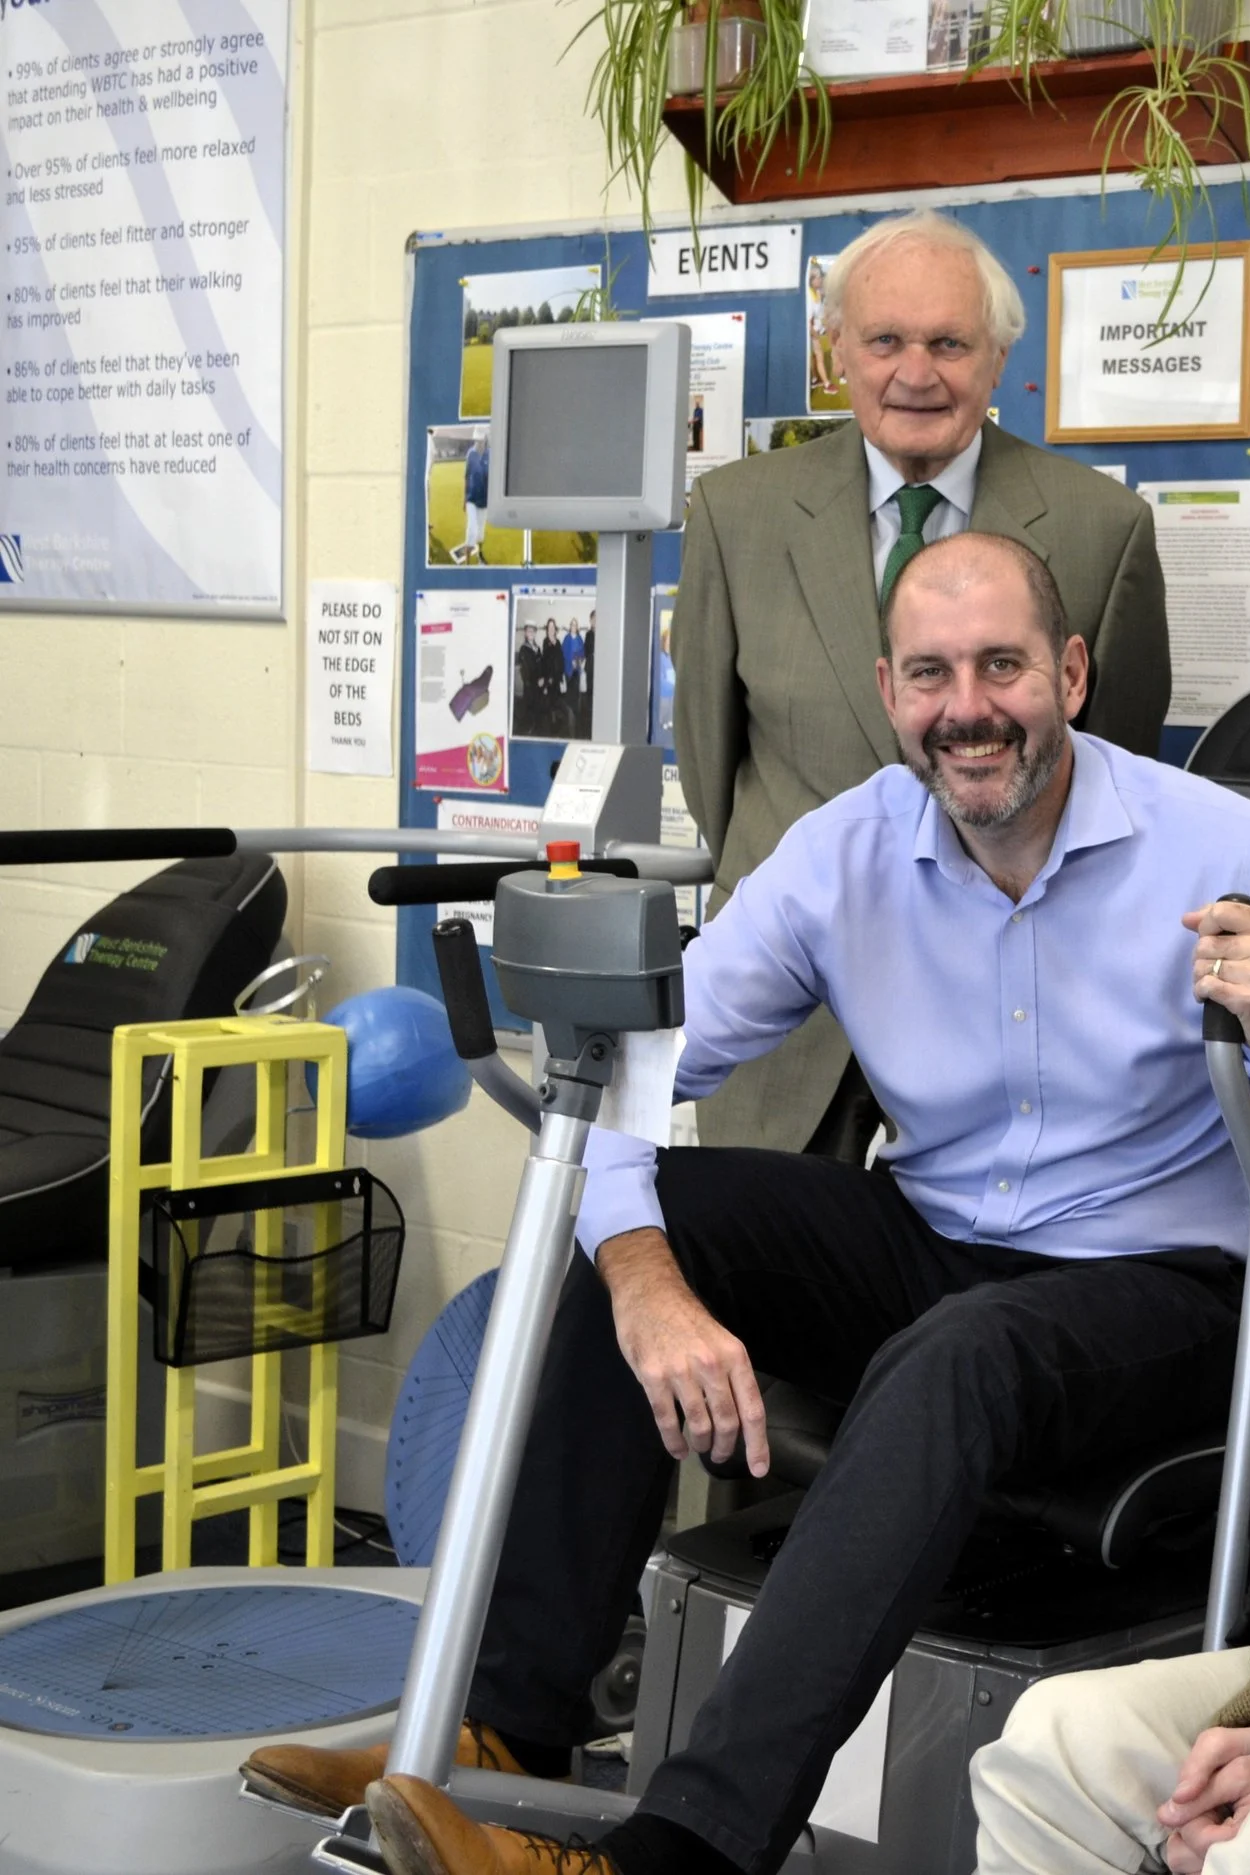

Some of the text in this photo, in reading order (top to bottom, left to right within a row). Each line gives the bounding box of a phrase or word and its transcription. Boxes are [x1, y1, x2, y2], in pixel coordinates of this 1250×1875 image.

[16, 32, 264, 80] 99% of clients agree or strongly agree
[8, 57, 258, 107] that attending WBTC has had a positive
[8, 88, 217, 134] impact on their health & wellbeing
[15, 136, 256, 180] Over 95% of clients feel more relaxed
[7, 179, 104, 206] and less stressed
[14, 217, 250, 255] 95% of clients feel fitter and stronger
[678, 242, 769, 275] EVENTS
[14, 271, 243, 304] 80% of clients feel that their walking
[7, 309, 82, 331] has improved
[1100, 321, 1207, 342] IMPORTANT
[14, 350, 240, 378] 86% of clients feel that they've been
[1102, 356, 1203, 376] MESSAGES
[7, 377, 216, 405] able to cope better with daily tasks
[14, 427, 252, 452] 80% of clients feel that at least one of
[7, 454, 217, 477] their health concerns have reduced
[322, 602, 382, 619] PLEASE DO
[318, 629, 383, 646] NOT SIT ON
[322, 656, 376, 673] THE EDGE
[329, 684, 367, 700] OF THE
[334, 711, 362, 727] BEDS
[331, 736, 366, 747] THANK YOU
[452, 814, 539, 833] CONTRAINDICATIO
[453, 910, 493, 921] PREGNANCY
